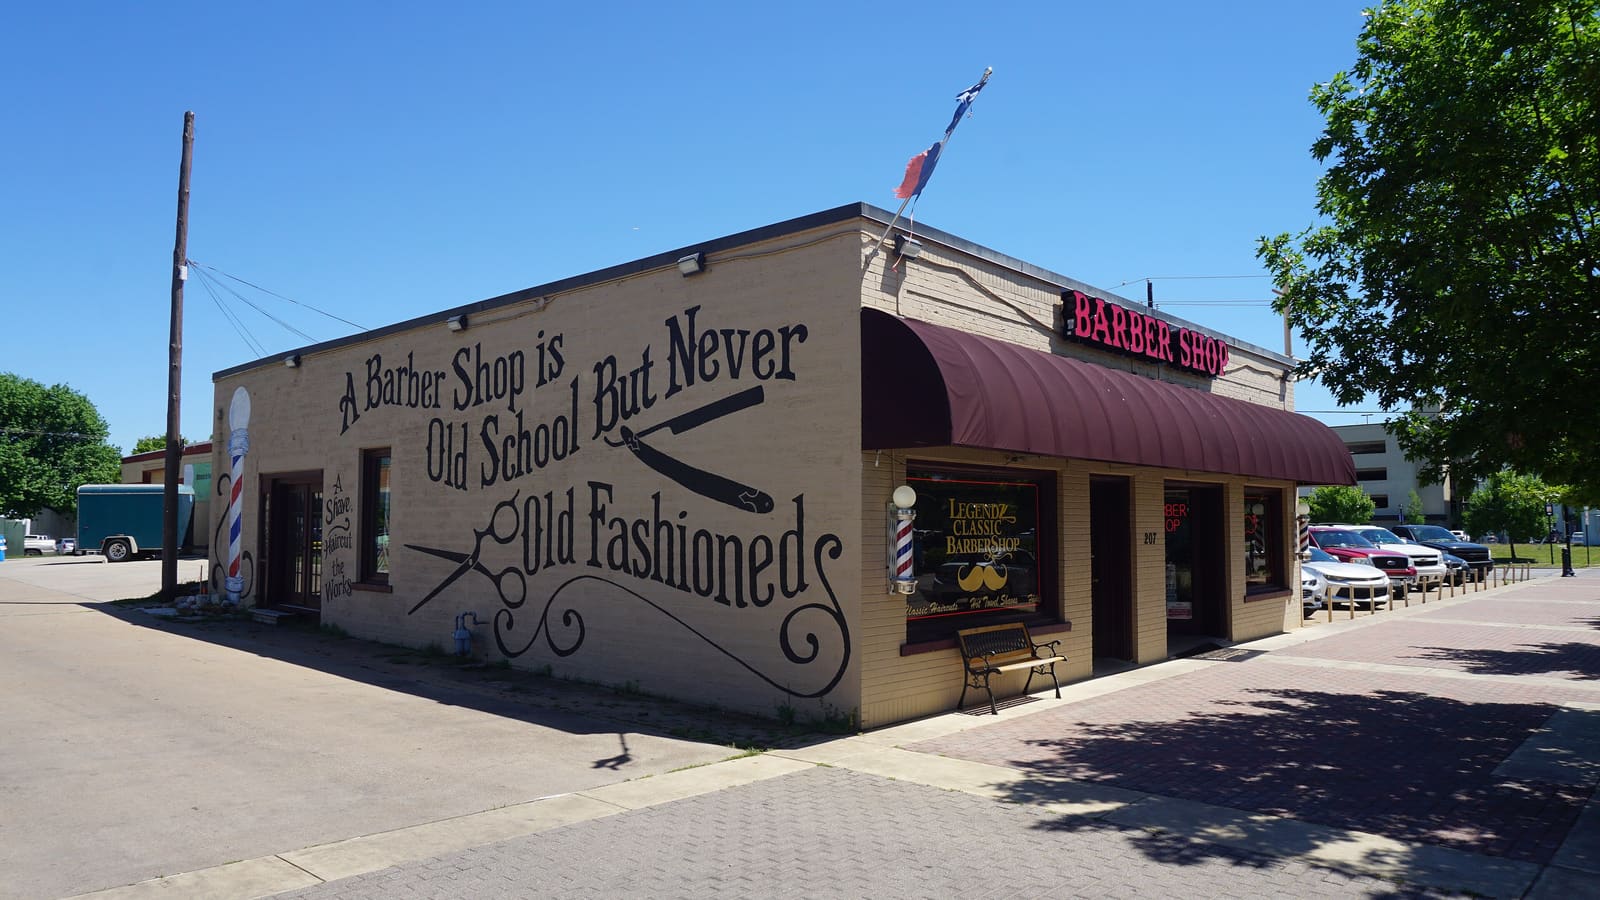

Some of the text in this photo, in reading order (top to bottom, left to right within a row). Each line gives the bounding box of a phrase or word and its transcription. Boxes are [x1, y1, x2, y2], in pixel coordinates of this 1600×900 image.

[1073, 290, 1230, 376] BARBER SHOP
[340, 329, 566, 436] A Barber Shop is
[592, 305, 808, 440] But Never
[426, 375, 580, 491] Old School
[333, 473, 343, 495] A
[948, 498, 1016, 523] LEGENDZ
[1164, 503, 1187, 517] BER
[953, 519, 1002, 536] CLASSIC
[1166, 519, 1181, 532] OP
[323, 533, 352, 560] Haircut
[521, 480, 809, 609] Old Fashioned
[946, 535, 1020, 555] BARBERSHOP
[1144, 532, 1157, 545] 207
[332, 558, 344, 577] the
[325, 574, 352, 603] Works
